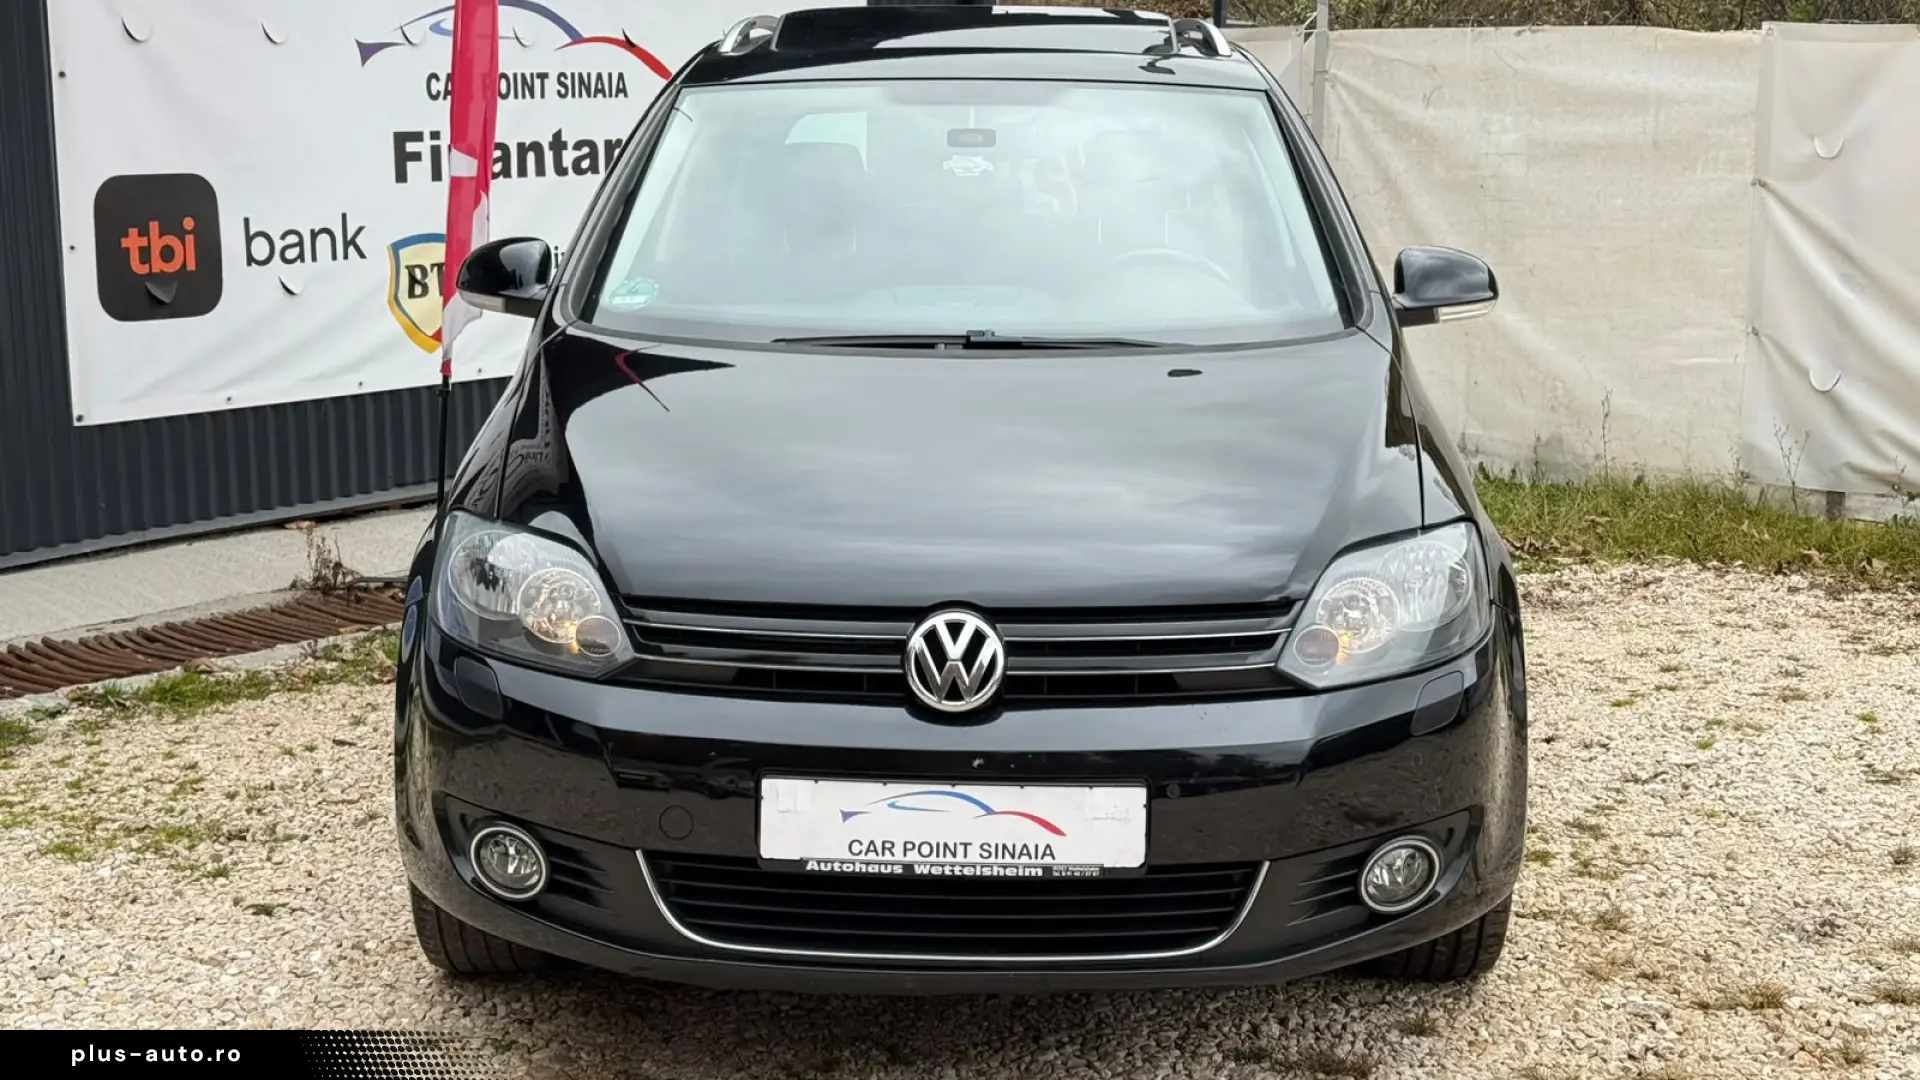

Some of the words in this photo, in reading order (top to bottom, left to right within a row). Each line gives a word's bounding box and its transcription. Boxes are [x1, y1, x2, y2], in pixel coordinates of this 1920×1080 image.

[426, 72, 453, 100] CA
[482, 72, 549, 100] OINT
[556, 72, 628, 99] SINAIA
[393, 128, 623, 184] Fiantar
[121, 217, 196, 275] tbi
[243, 212, 367, 266] bank
[405, 262, 445, 299] BT
[909, 611, 1002, 709] VW
[806, 860, 903, 874] Autohaus
[914, 864, 1043, 877] Wettelsheim
[848, 839, 895, 857] CAR
[903, 841, 972, 859] POINT
[979, 842, 1056, 861] SINAIA
